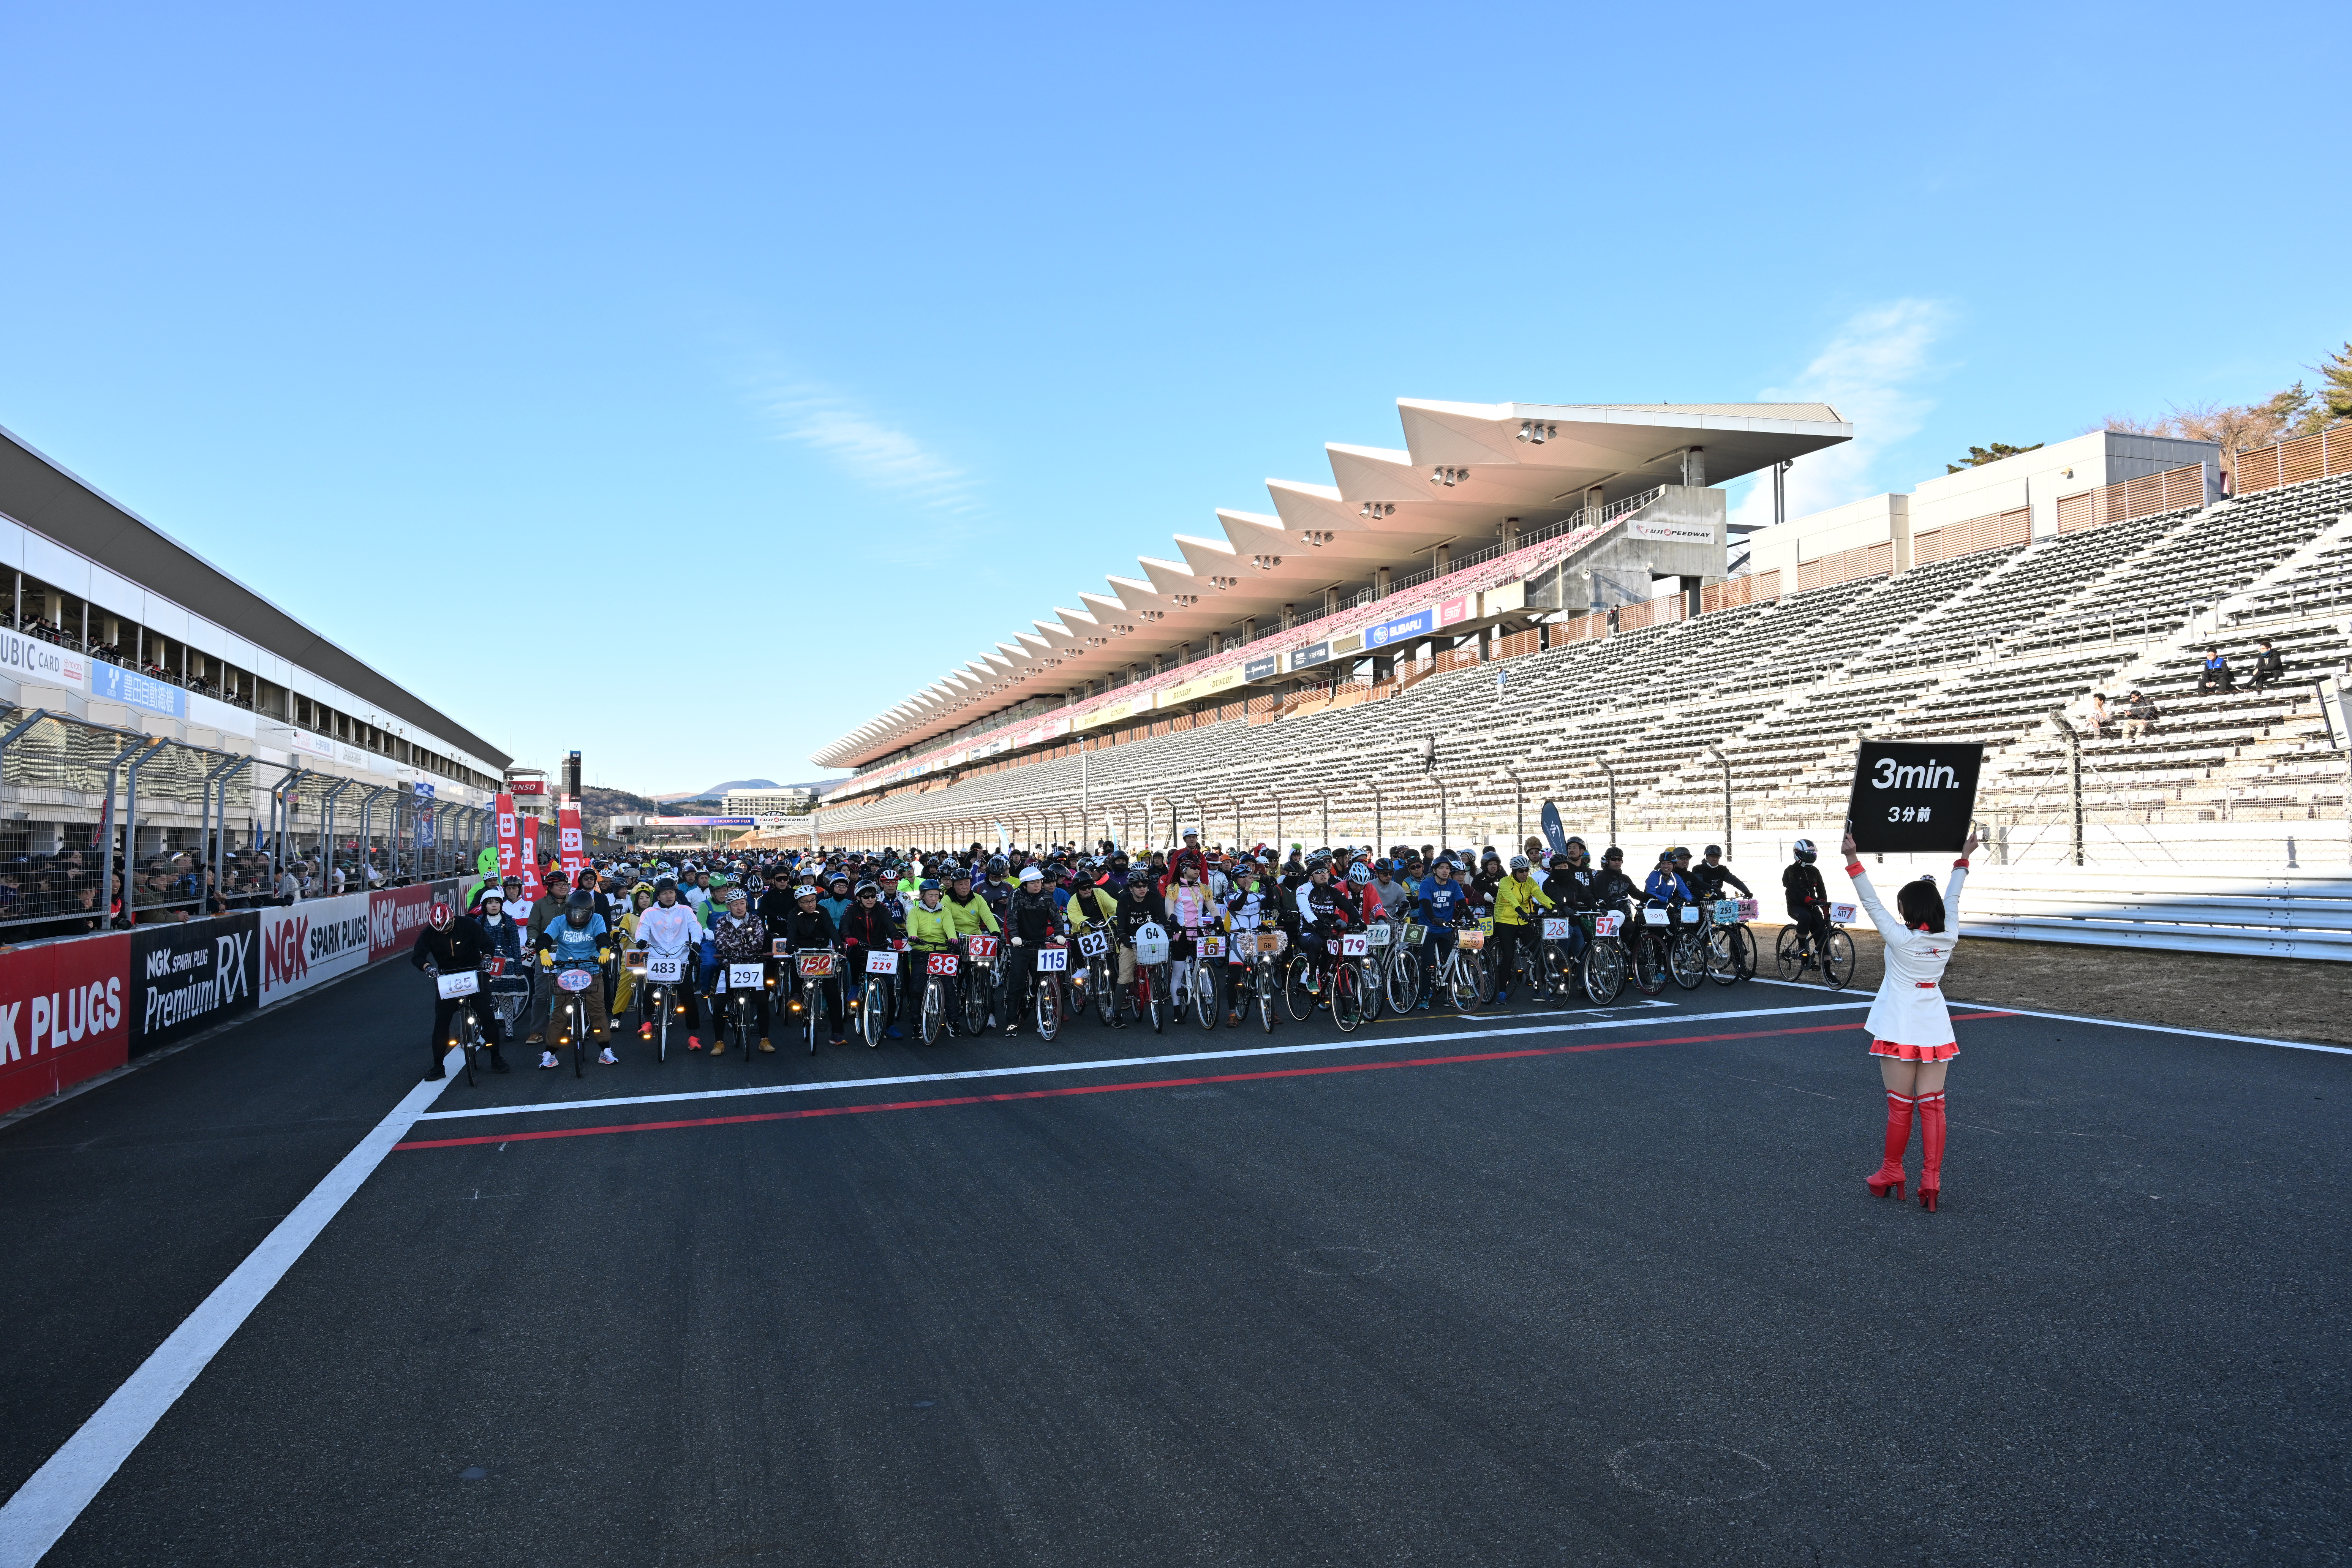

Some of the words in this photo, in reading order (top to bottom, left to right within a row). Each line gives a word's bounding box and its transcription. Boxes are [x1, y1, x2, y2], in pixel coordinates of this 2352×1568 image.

[1389, 619, 1421, 637] SUBARU
[39, 652, 59, 672] CARD
[69, 661, 82, 671] TOYOTA
[1212, 675, 1233, 688] DUNLOP
[107, 689, 116, 697] TOYOTA
[123, 674, 174, 713] 豊田自動織機
[1173, 688, 1191, 699] DUNLOP
[1111, 708, 1125, 716] DUNLOP
[301, 732, 310, 741] TOYOTA
[1017, 736, 1030, 744] NISSAN
[1042, 729, 1056, 738] NISSAN
[343, 747, 361, 764] BRIDGESTONE
[1872, 758, 1960, 789] 3min.
[1888, 806, 1932, 822] 3分前
[371, 896, 395, 952] NGK
[396, 903, 414, 932] SPARK
[416, 900, 430, 928] PLUGS
[1130, 915, 1153, 924] 辰巳屋
[1596, 918, 1613, 934] 57
[1146, 928, 1159, 939] 64
[1367, 929, 1388, 938] 510
[1546, 922, 1565, 936] 28
[971, 937, 996, 955] 37
[1082, 934, 1105, 954] 82
[1208, 944, 1215, 955] 6
[1328, 940, 1337, 954] 79
[1345, 939, 1365, 953] 79
[265, 913, 308, 993] NGK
[310, 922, 340, 961] SPARK
[342, 915, 367, 950] PLUGS
[522, 953, 534, 962] 45
[147, 947, 171, 980] NGK
[172, 952, 192, 973] SPARK
[193, 948, 208, 967] PLUG
[801, 955, 830, 972] 150
[872, 962, 891, 970] 229
[929, 955, 957, 974] 38
[1041, 952, 1064, 969] 115
[214, 930, 252, 1008] RX
[651, 963, 675, 973] 483
[446, 977, 472, 991] 185
[562, 974, 589, 985] 326
[734, 972, 759, 983] 297
[144, 974, 214, 1034] Premium
[31, 976, 120, 1055] PLUGS
